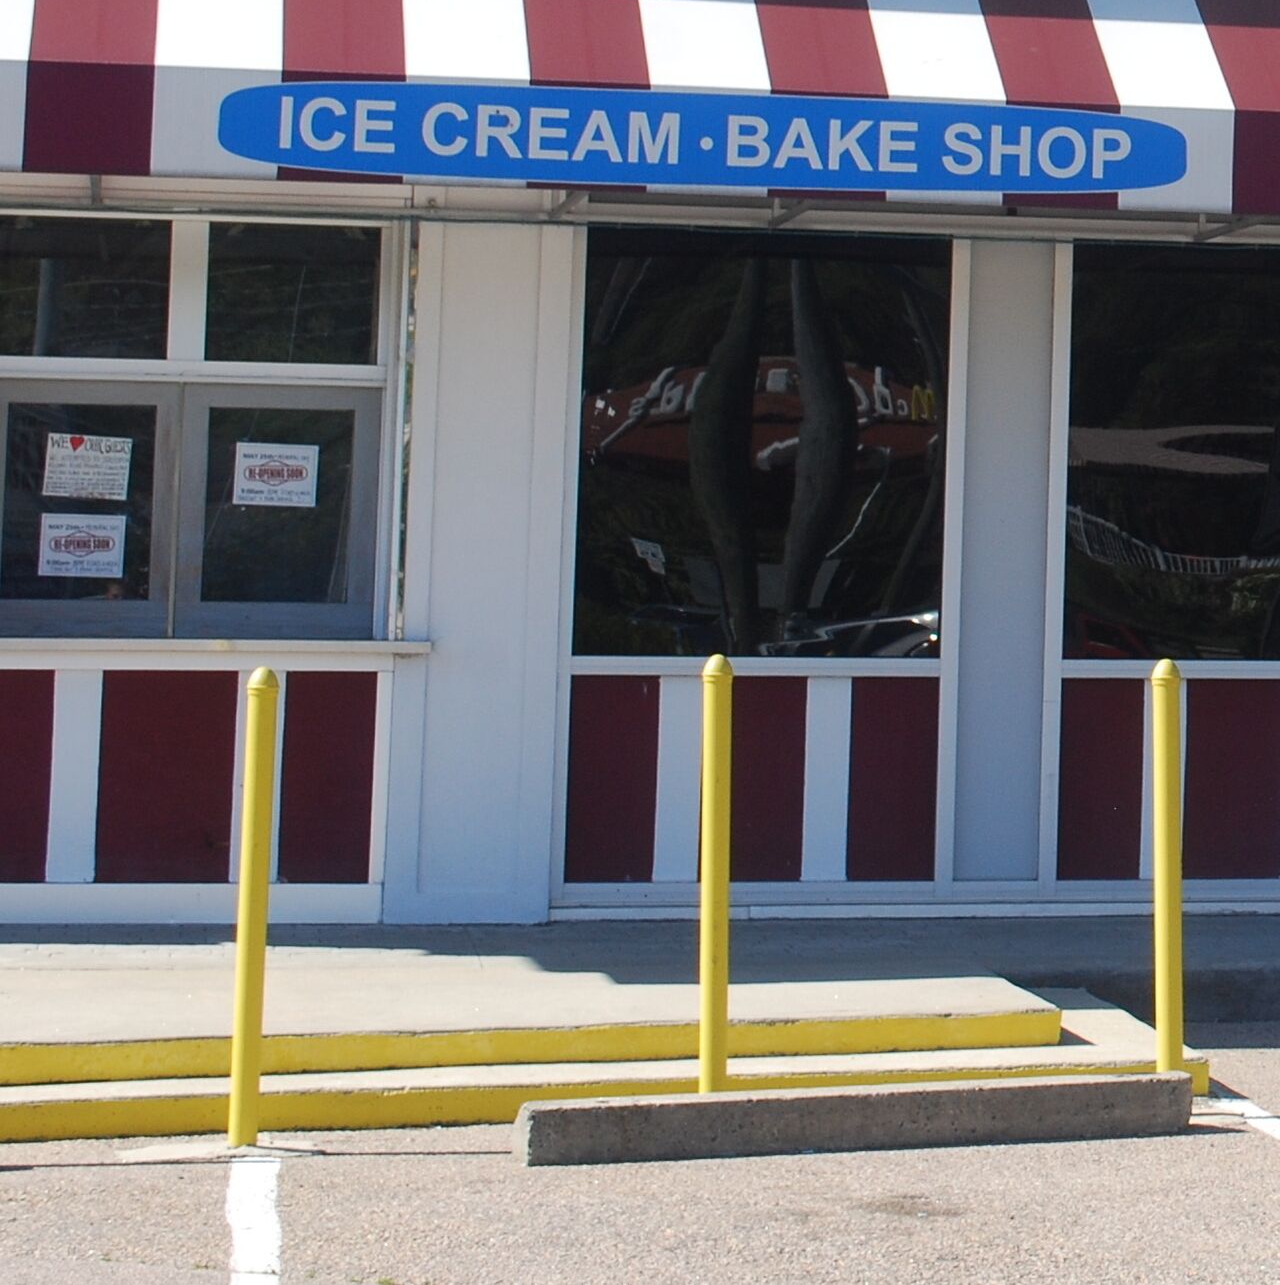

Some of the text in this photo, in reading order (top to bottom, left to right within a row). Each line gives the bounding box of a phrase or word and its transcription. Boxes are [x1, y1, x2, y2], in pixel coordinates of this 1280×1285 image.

[277, 96, 1132, 179] ICE CREAM BAKE SHOP
